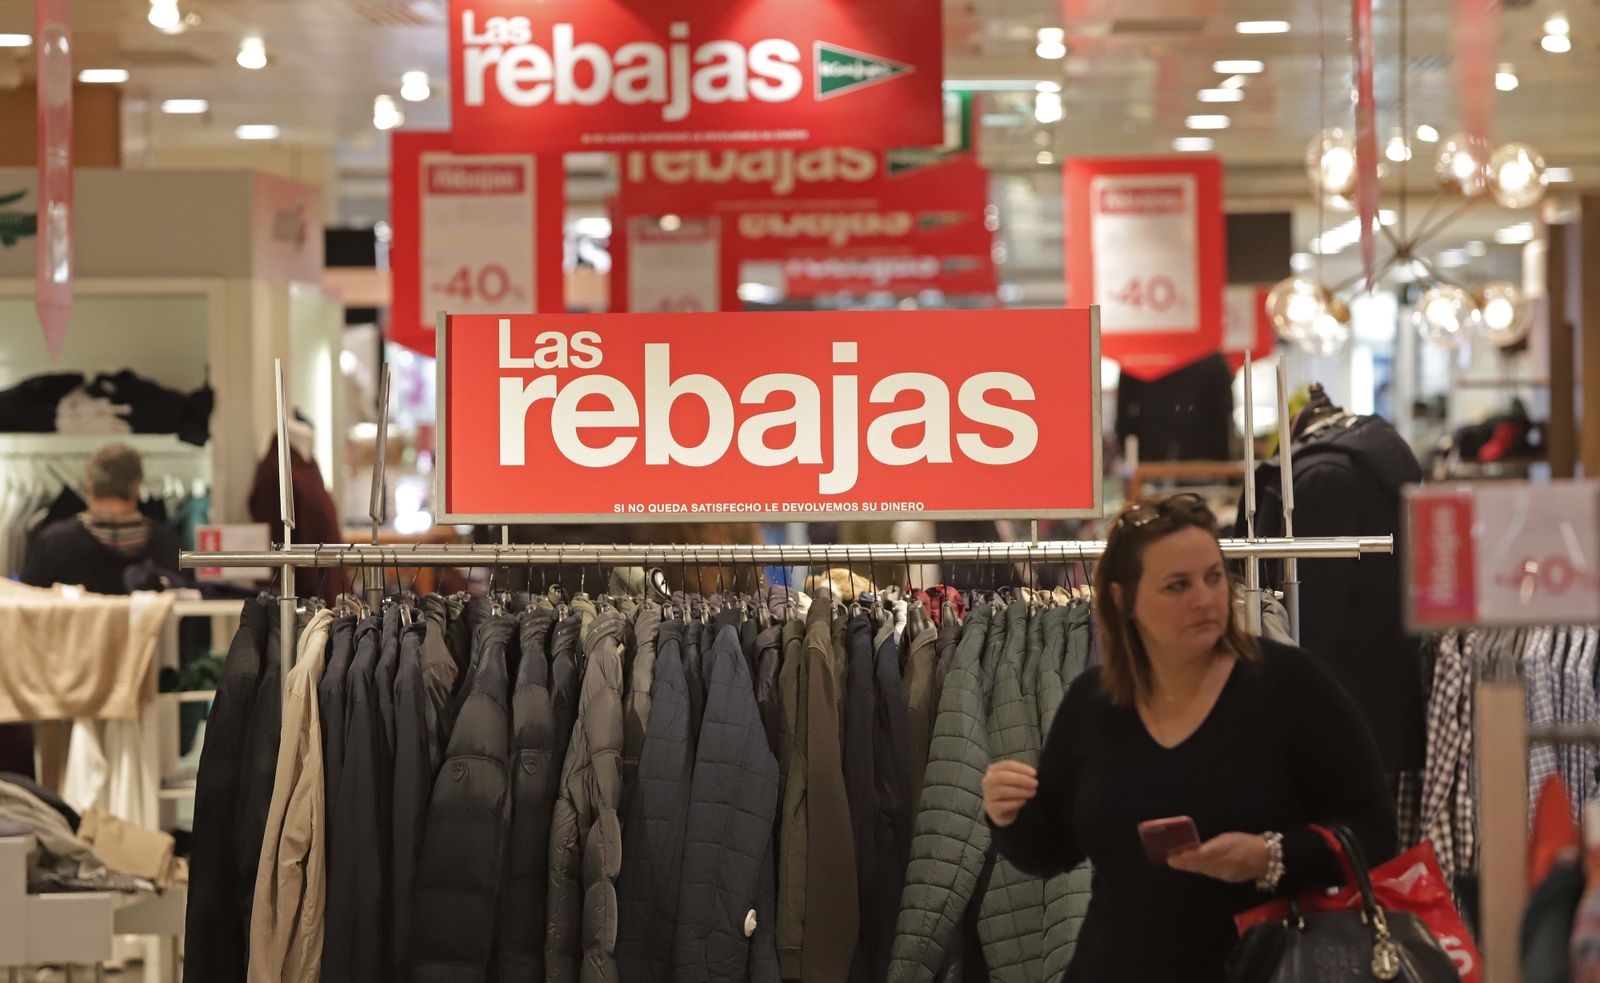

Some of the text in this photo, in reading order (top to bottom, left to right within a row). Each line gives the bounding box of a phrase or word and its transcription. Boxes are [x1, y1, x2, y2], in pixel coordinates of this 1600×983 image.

[462, 9, 532, 45] Las
[463, 22, 803, 122] rebajas
[498, 319, 604, 370] Las
[499, 341, 1039, 495] rebajas
[613, 501, 925, 513] SI NO QUEDA SATISFECHO LE DEVOLVEMOS SU DINERO
